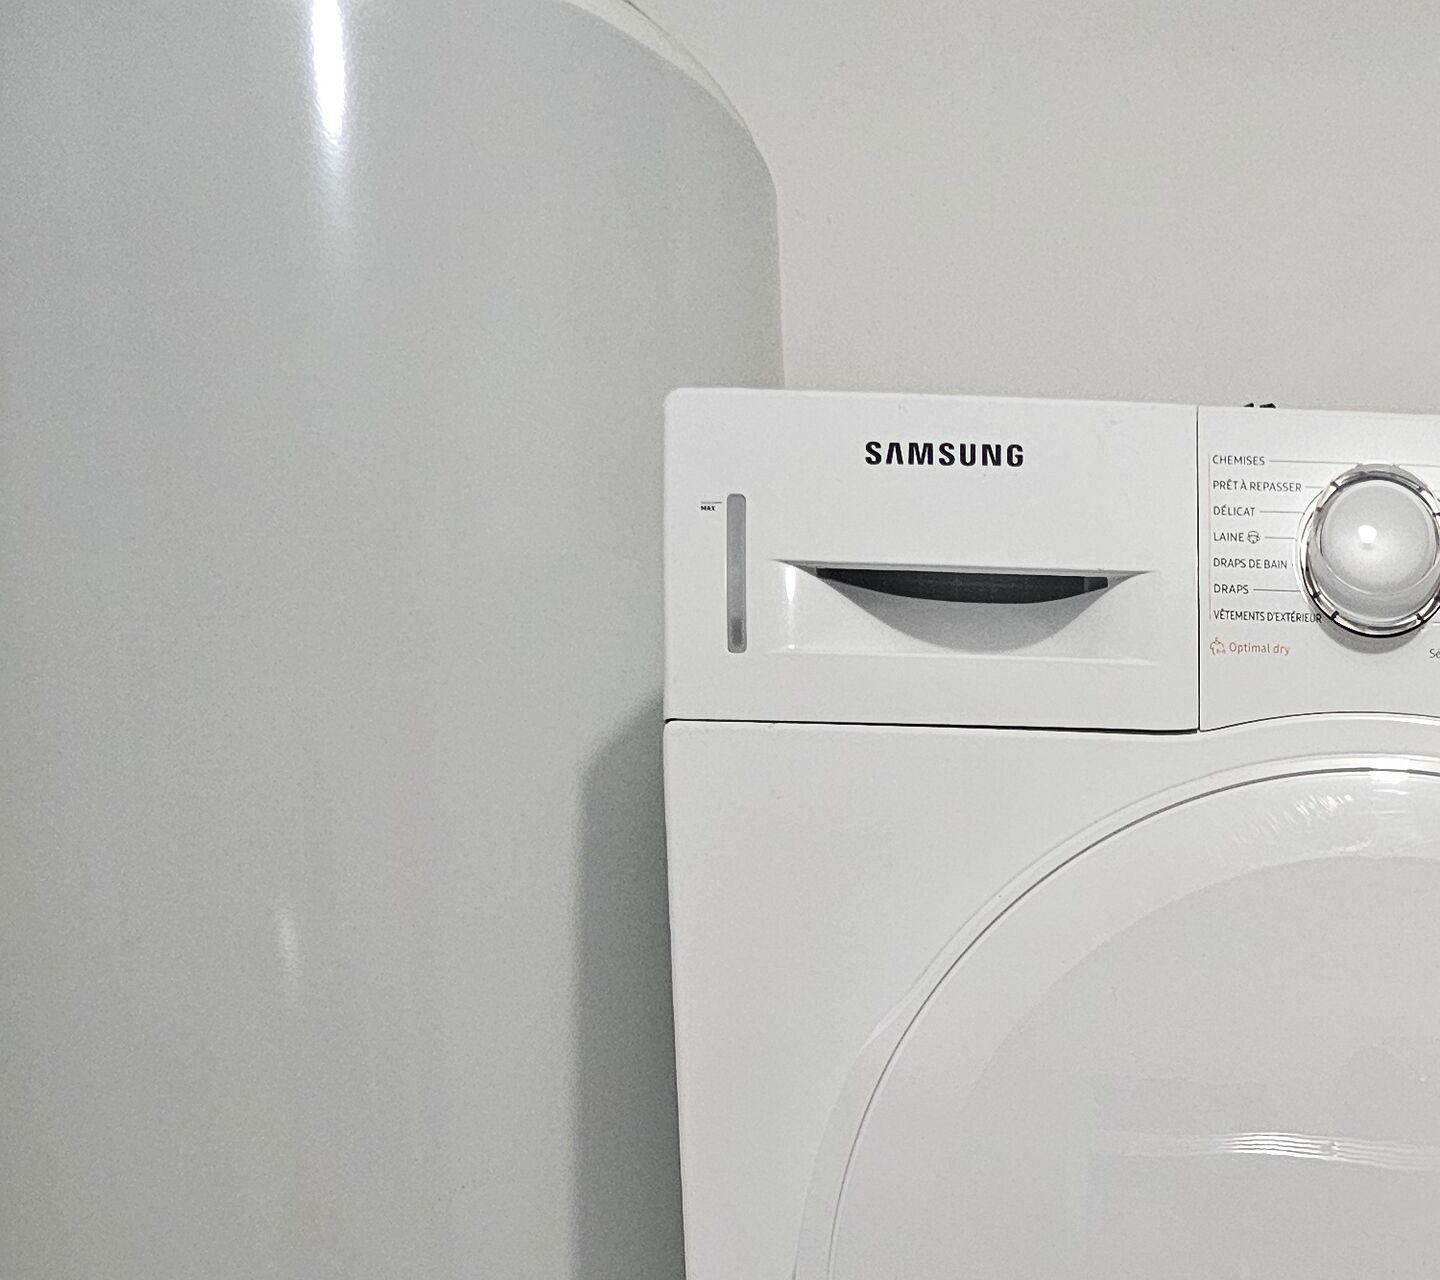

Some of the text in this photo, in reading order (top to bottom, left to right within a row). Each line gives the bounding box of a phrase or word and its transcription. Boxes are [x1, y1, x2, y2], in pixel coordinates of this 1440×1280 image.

[865, 441, 1024, 467] SAMSUNG
[1212, 454, 1265, 466] CHEMISES
[1213, 479, 1302, 492] PRÊT À REPASSER
[1213, 504, 1255, 516] DÉLICAT
[1213, 532, 1244, 542] LAINE
[1213, 557, 1287, 569] DRAPS DE BAIN
[1213, 583, 1249, 594] DRAPS
[1213, 608, 1322, 623] VÊTEMENTS D'EXTÉRIEUR
[1229, 642, 1290, 656] Optimal dry
